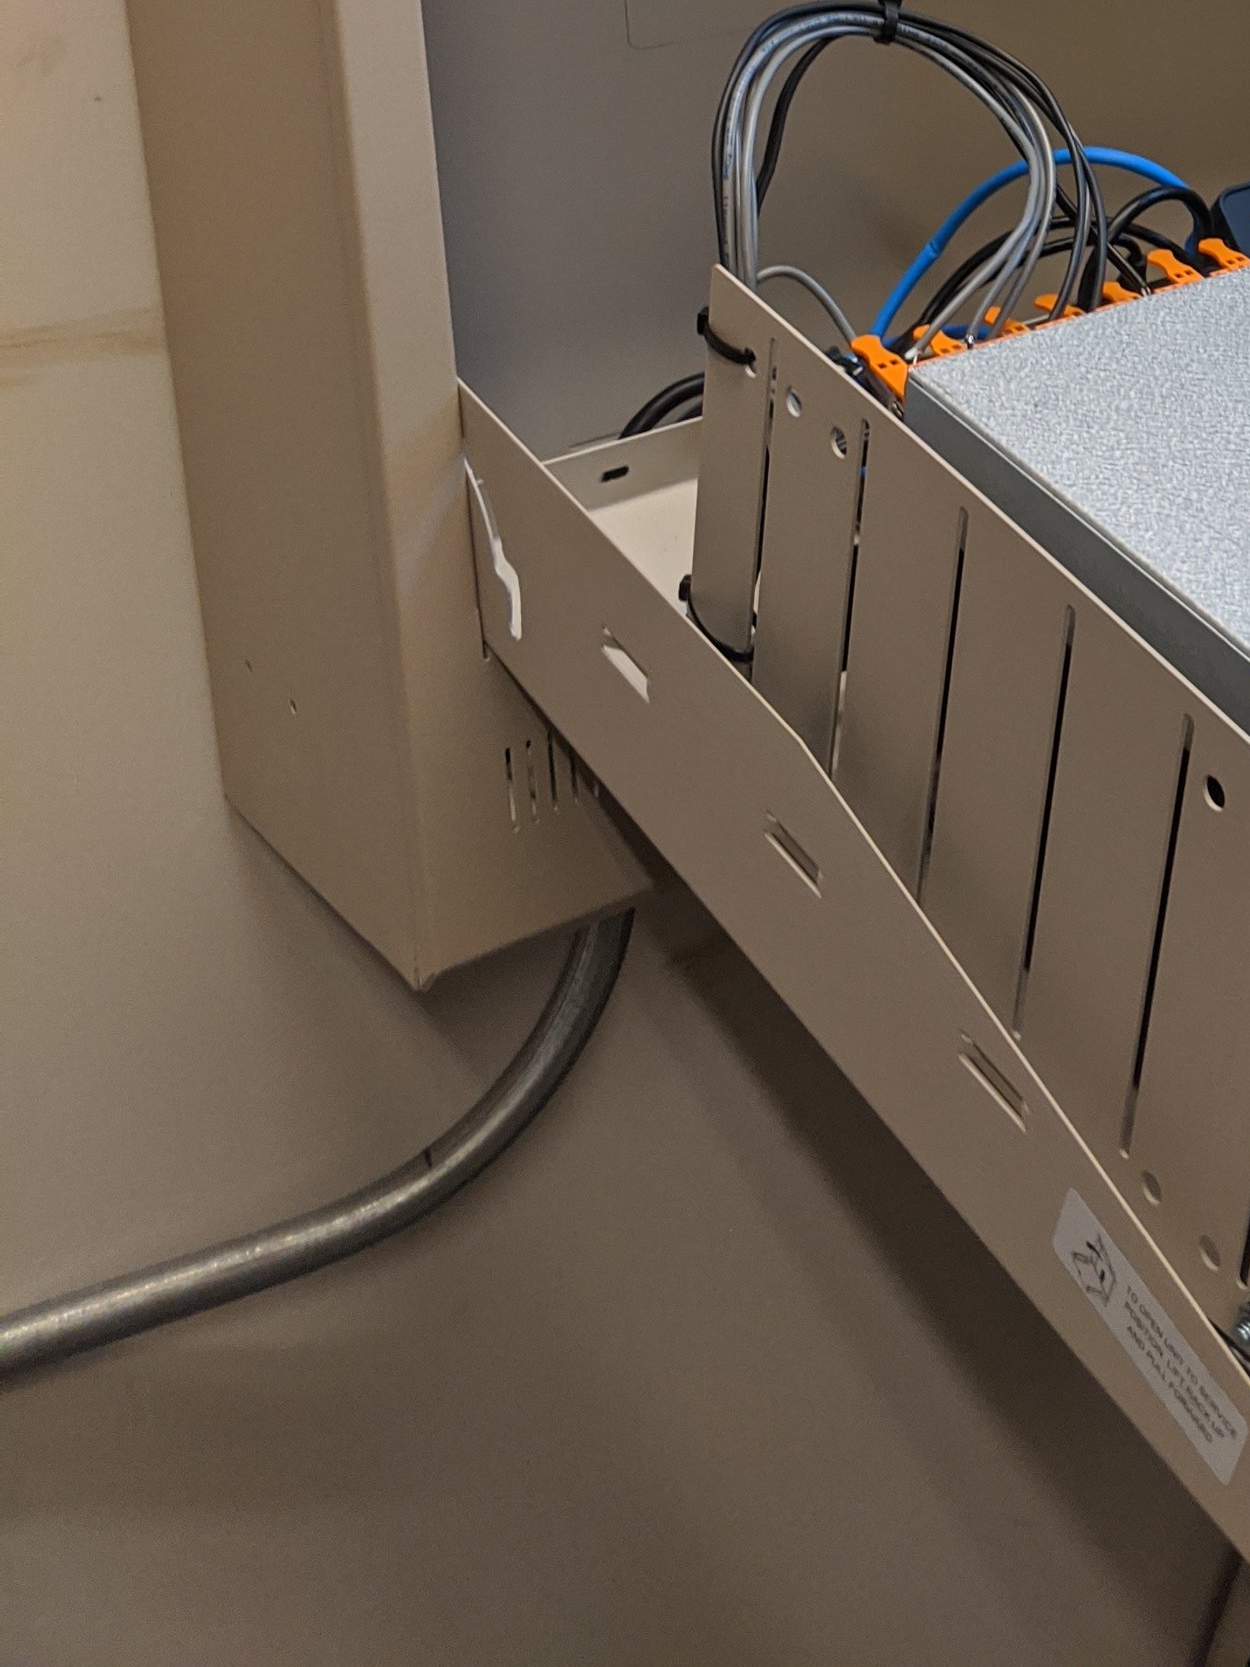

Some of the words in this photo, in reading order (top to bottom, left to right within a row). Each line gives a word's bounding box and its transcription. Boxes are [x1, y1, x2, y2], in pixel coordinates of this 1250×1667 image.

[1126, 1284, 1139, 1304] TO
[1139, 1303, 1163, 1339] OPEN
[1164, 1338, 1184, 1365] UNIT
[1186, 1366, 1198, 1385] TO
[1199, 1385, 1237, 1439] SERVICE
[1126, 1325, 1146, 1351] AND
[1146, 1350, 1167, 1384] PULL
[1168, 1381, 1213, 1444] FORWARD
[1166, 1359, 1185, 1387] LIFT
[1186, 1386, 1210, 1421] RACK
[1211, 1420, 1225, 1439] UP
